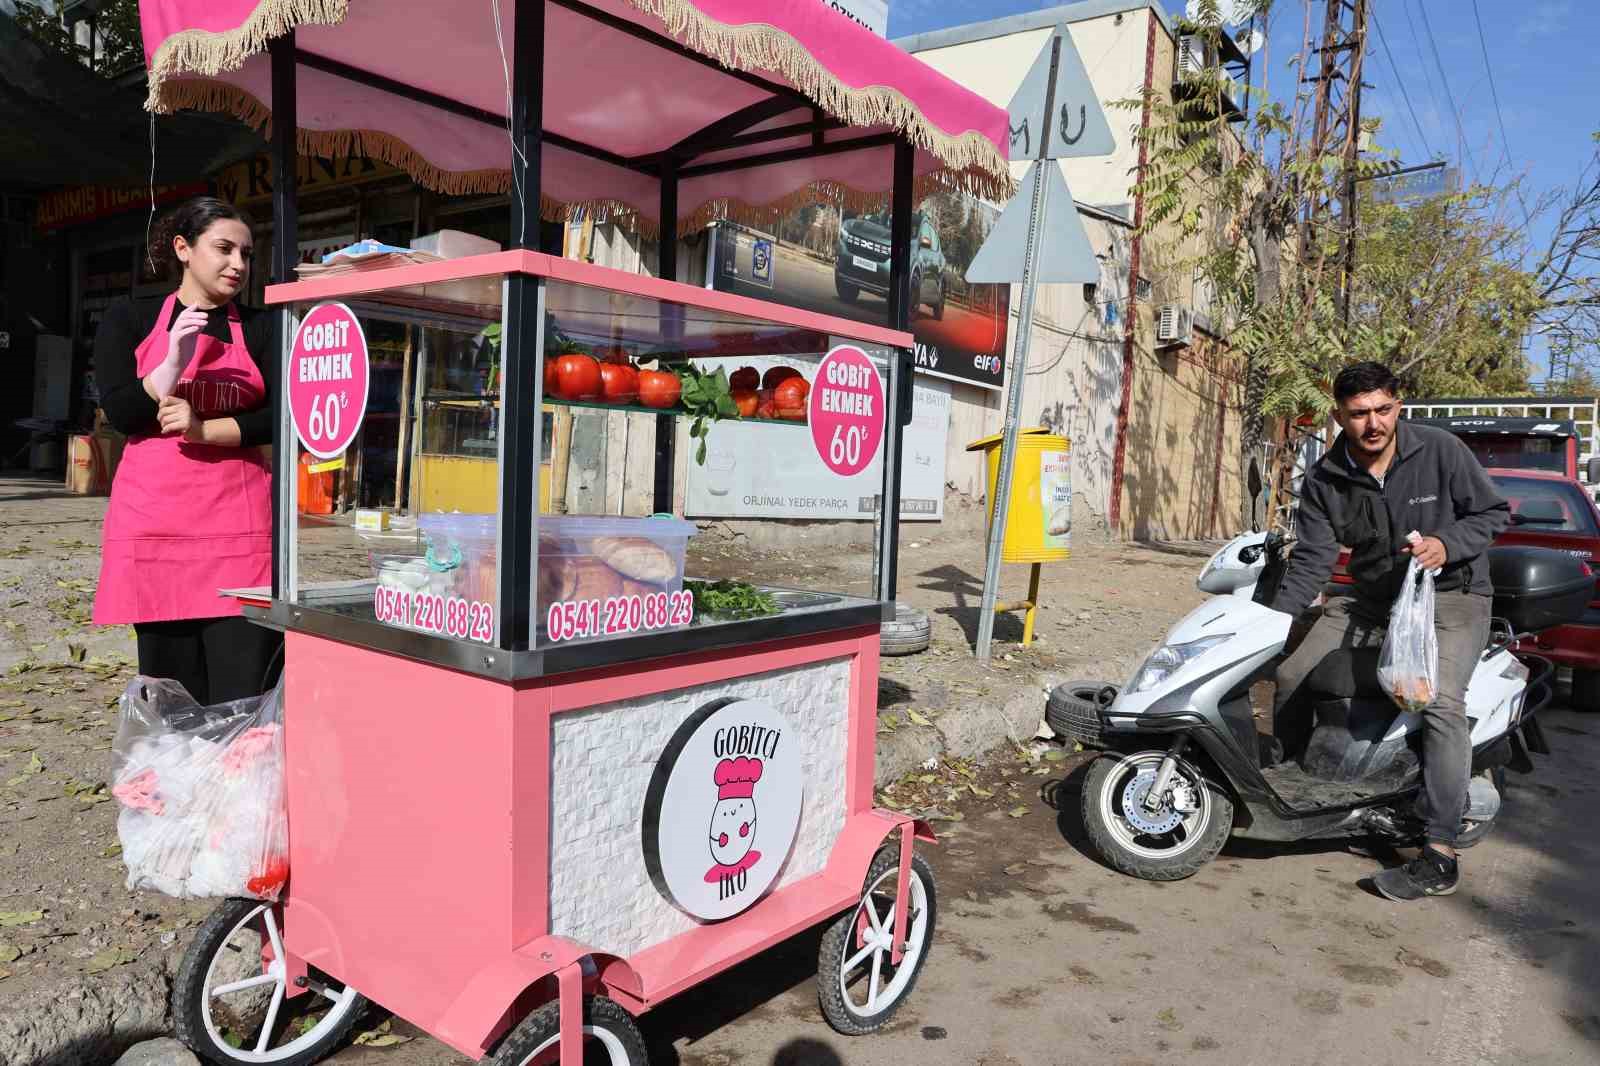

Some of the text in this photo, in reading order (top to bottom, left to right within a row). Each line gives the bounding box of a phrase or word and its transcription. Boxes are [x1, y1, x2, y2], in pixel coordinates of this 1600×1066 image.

[298, 353, 353, 383] EKMEK
[974, 354, 991, 371] elf
[821, 388, 874, 417] EKMEK
[788, 496, 817, 508] YEDEK
[375, 585, 493, 642] 0541 220 88 23
[548, 589, 694, 641] 0541 220 88 23
